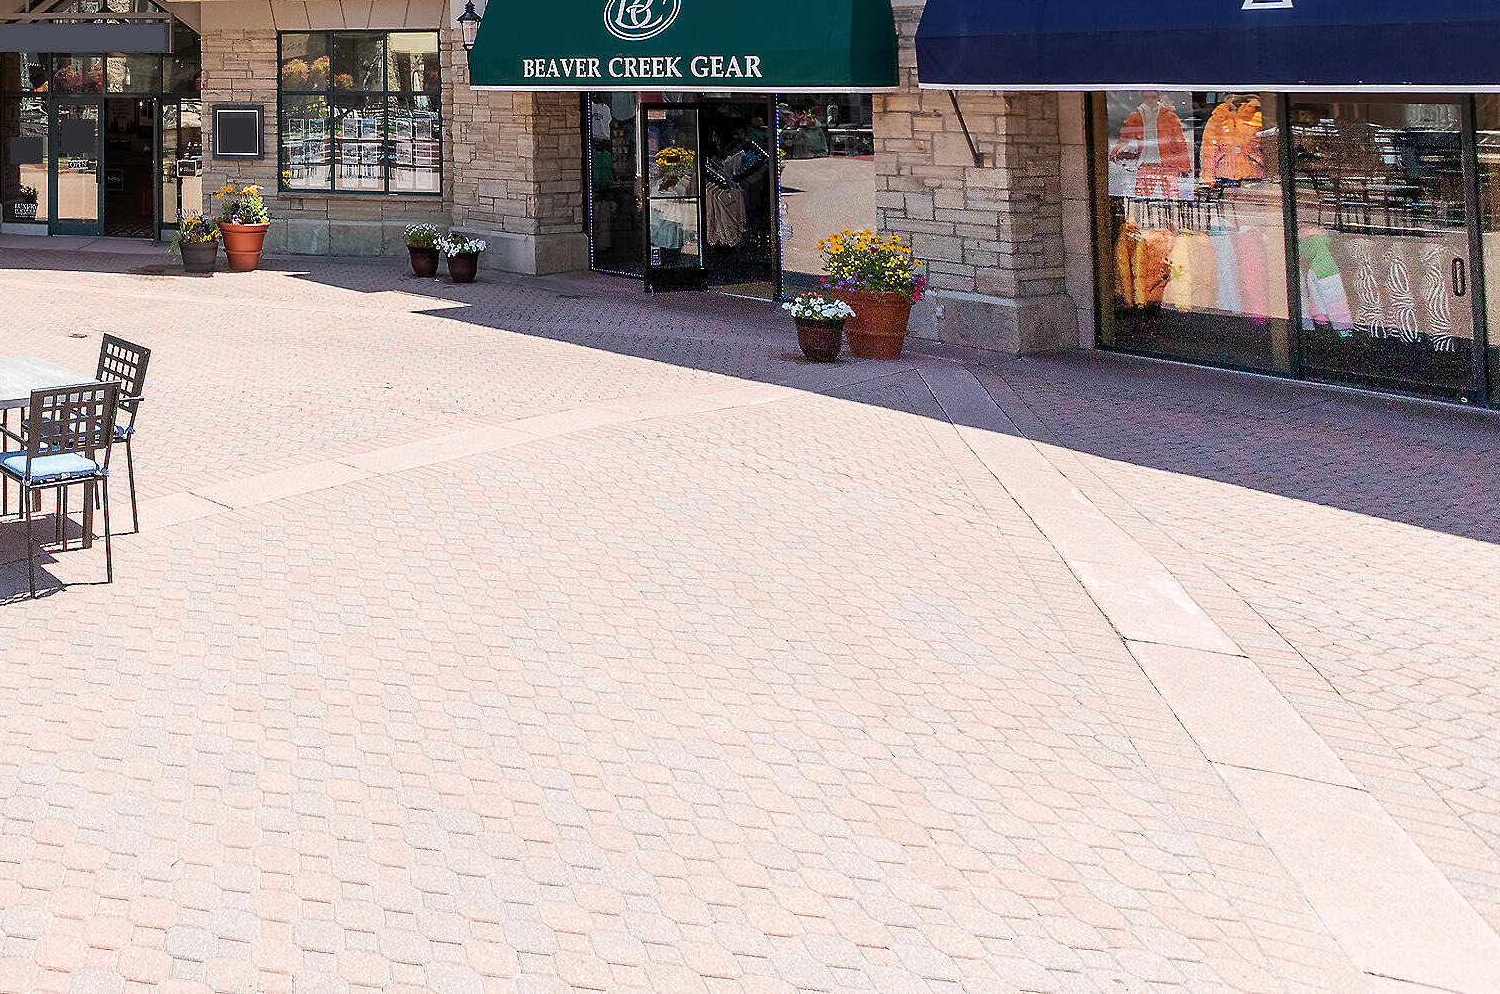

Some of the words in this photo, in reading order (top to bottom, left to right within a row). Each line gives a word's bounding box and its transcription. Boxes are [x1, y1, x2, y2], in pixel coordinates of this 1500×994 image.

[522, 58, 602, 79] BEAVER
[608, 56, 683, 78] CREEK
[690, 55, 763, 78] GEAR
[69, 161, 88, 169] OPEN
